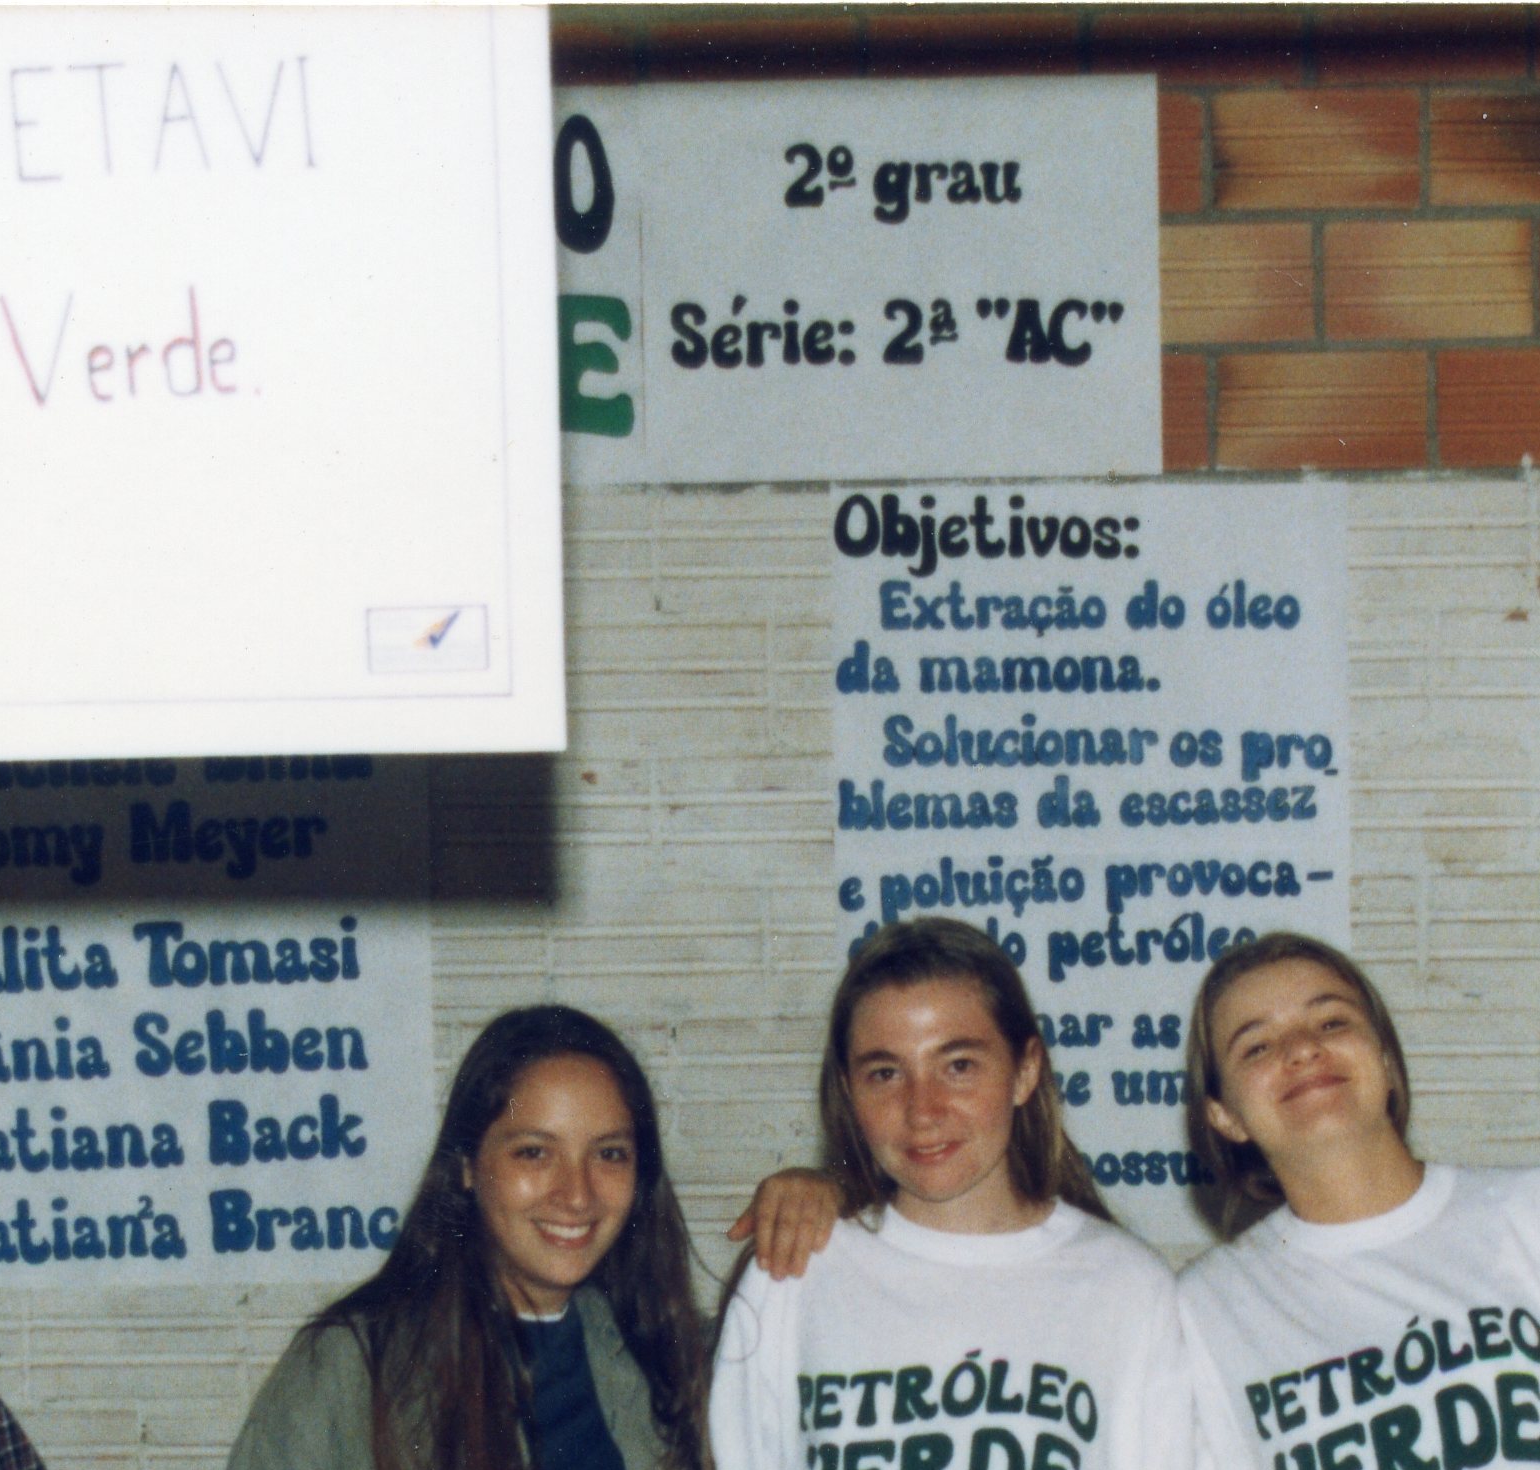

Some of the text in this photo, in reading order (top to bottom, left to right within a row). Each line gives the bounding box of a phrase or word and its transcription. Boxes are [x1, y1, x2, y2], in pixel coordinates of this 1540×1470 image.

[10, 56, 316, 183] ETAVI
[873, 157, 1021, 223] grau
[671, 295, 856, 366] Série:
[834, 494, 1139, 576] Objetivos:
[879, 581, 1301, 638] Extração do óleo
[837, 642, 1161, 693] da mamona.
[883, 715, 1158, 768] Solucionar
[1169, 729, 1223, 767] os
[838, 775, 1317, 829] blemas da escassez
[129, 800, 328, 879] Meyer
[838, 875, 866, 911] e
[880, 855, 1084, 918] poluição
[132, 915, 360, 988] Tomasi
[132, 1008, 369, 1078] Sebben
[1131, 1013, 1181, 1049] as
[208, 1093, 367, 1166] Back
[209, 1188, 401, 1253] Branc
